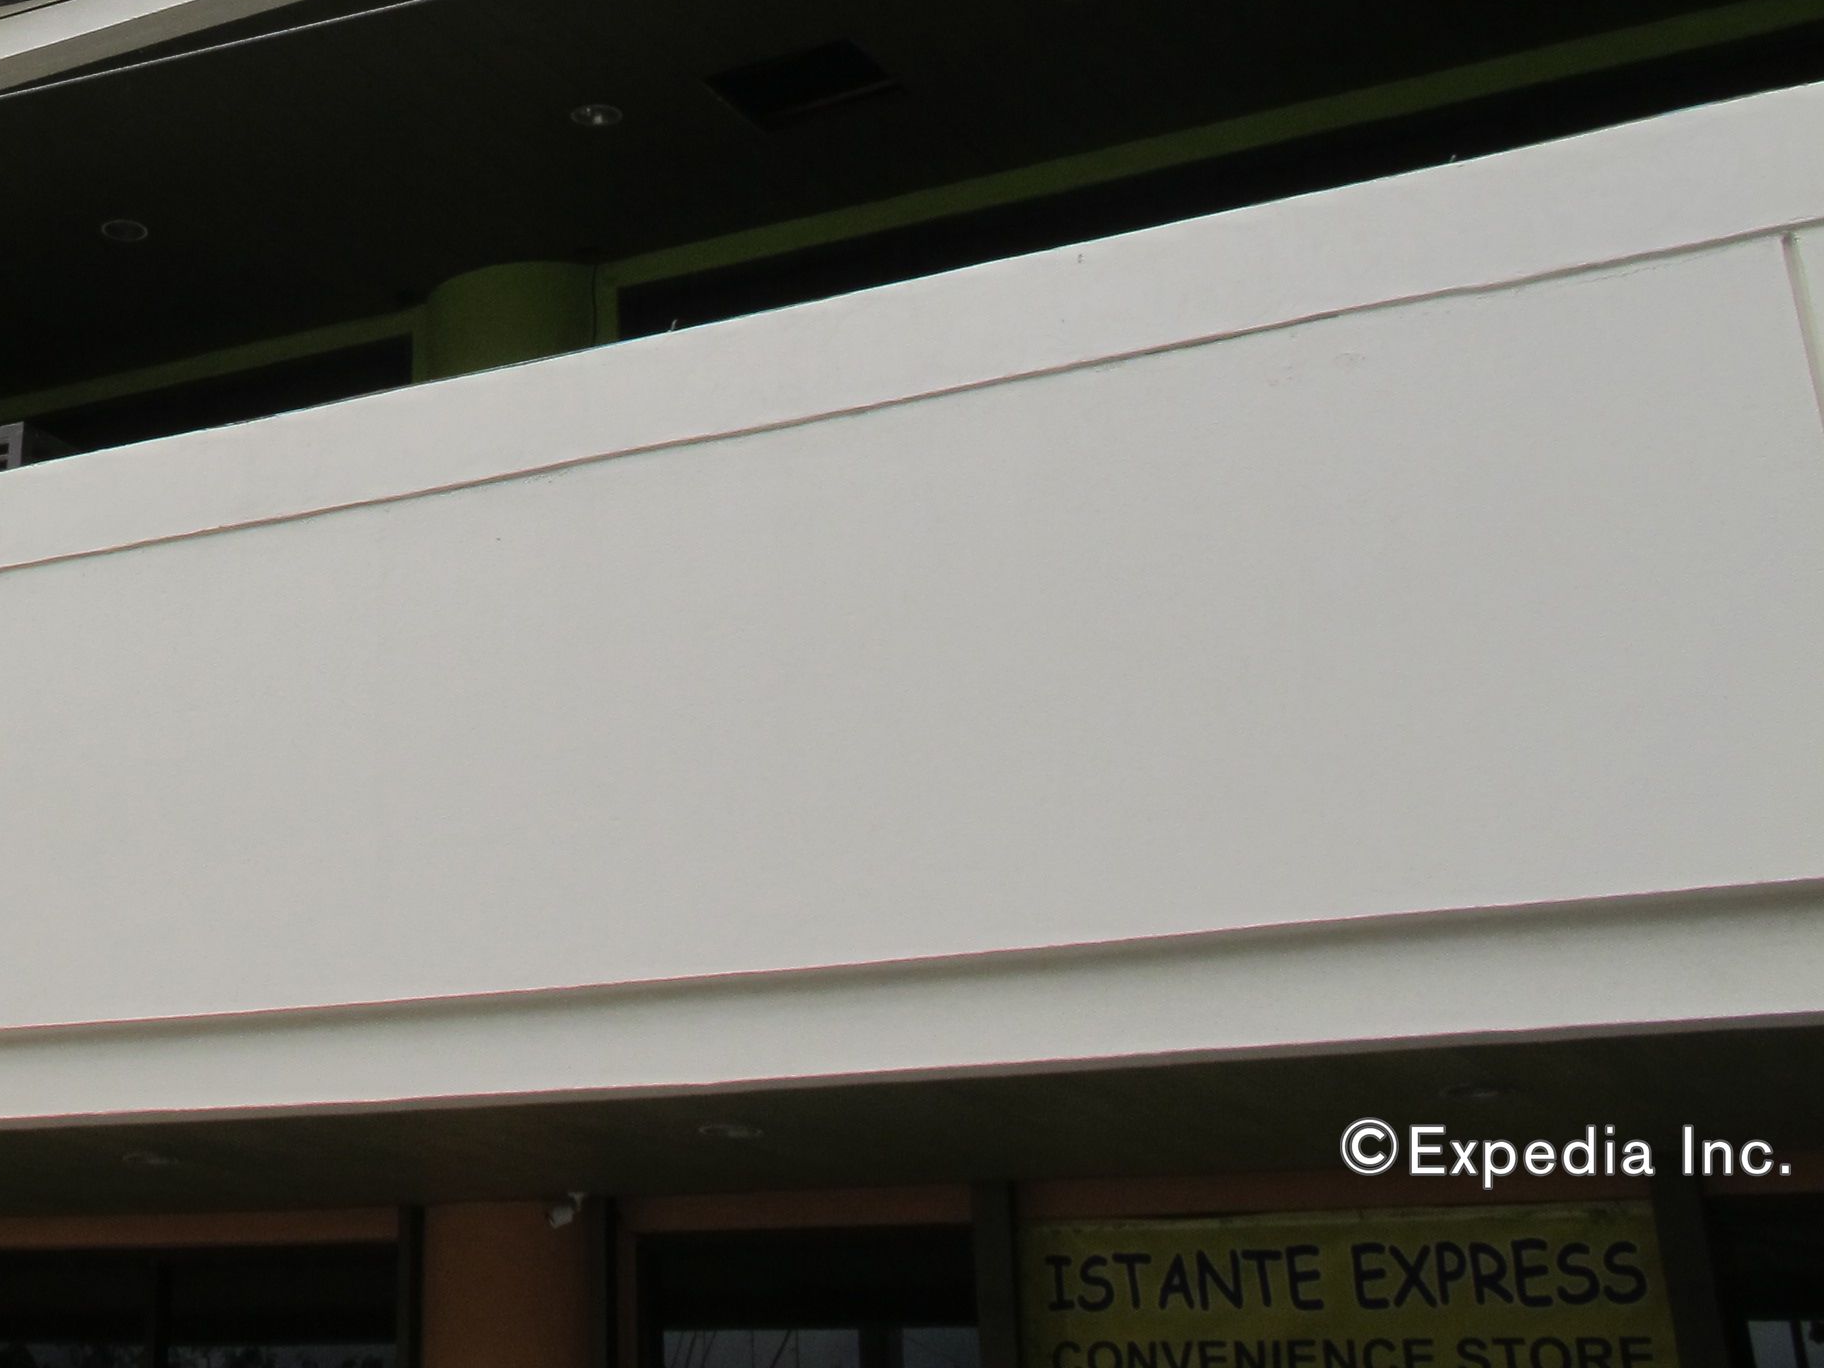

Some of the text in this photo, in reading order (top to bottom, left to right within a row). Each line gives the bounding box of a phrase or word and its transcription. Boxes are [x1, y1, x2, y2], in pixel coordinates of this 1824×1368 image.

[1044, 1238, 1648, 1312] ISTANTE EXPRESS
[1052, 1336, 1654, 1368] CONVENIENCE STORE
